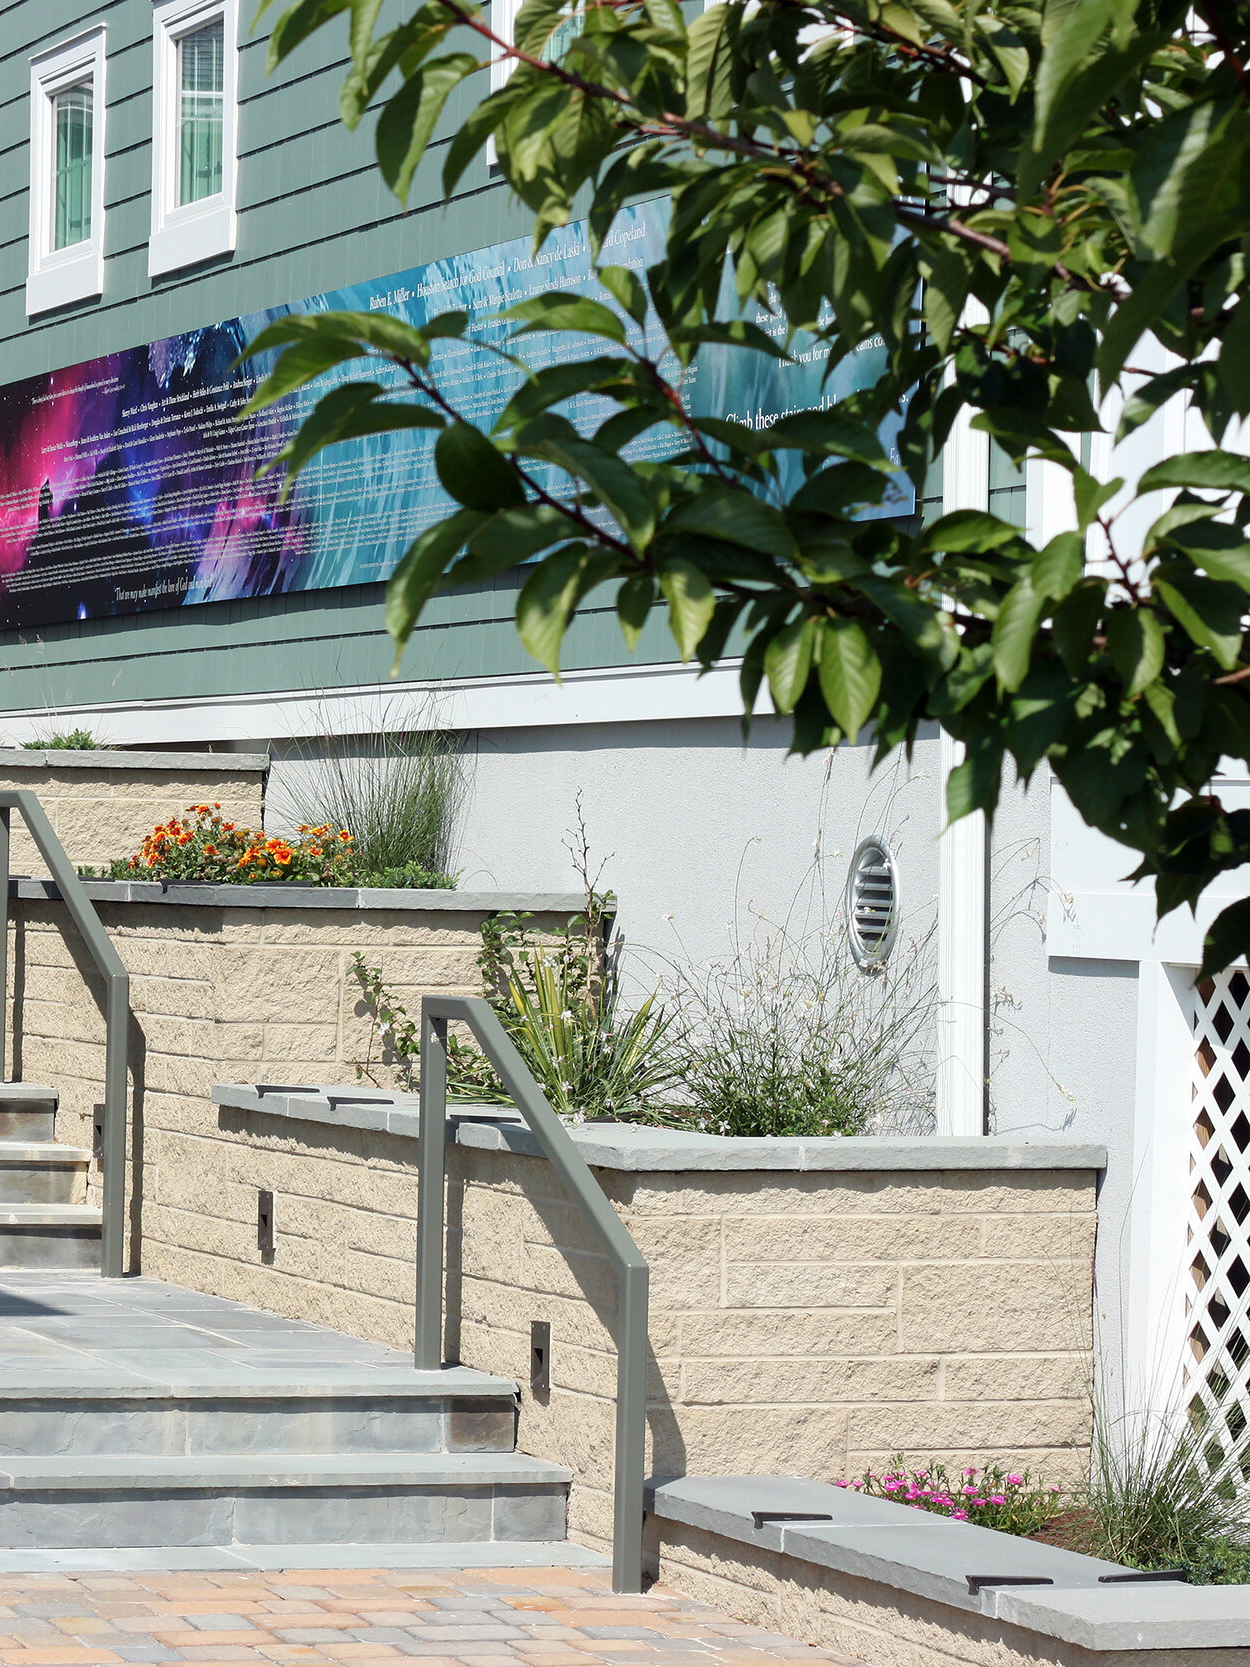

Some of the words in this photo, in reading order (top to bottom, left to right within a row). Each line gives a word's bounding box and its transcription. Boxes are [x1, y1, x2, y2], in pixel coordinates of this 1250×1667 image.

[614, 221, 646, 248] Copeland
[369, 294, 386, 310] Ruben
[394, 286, 410, 304] Miller
[417, 280, 439, 298] Houston
[440, 274, 458, 293] Search
[460, 272, 468, 288] for
[469, 266, 481, 284] God
[482, 261, 505, 280] Council
[514, 256, 527, 272] Don
[534, 250, 554, 268] Nancy
[555, 246, 563, 261] de
[564, 241, 580, 258] Laski
[756, 312, 768, 323] these
[777, 324, 785, 336] the
[799, 352, 811, 367] you
[813, 345, 822, 360] for
[755, 408, 778, 430] these
